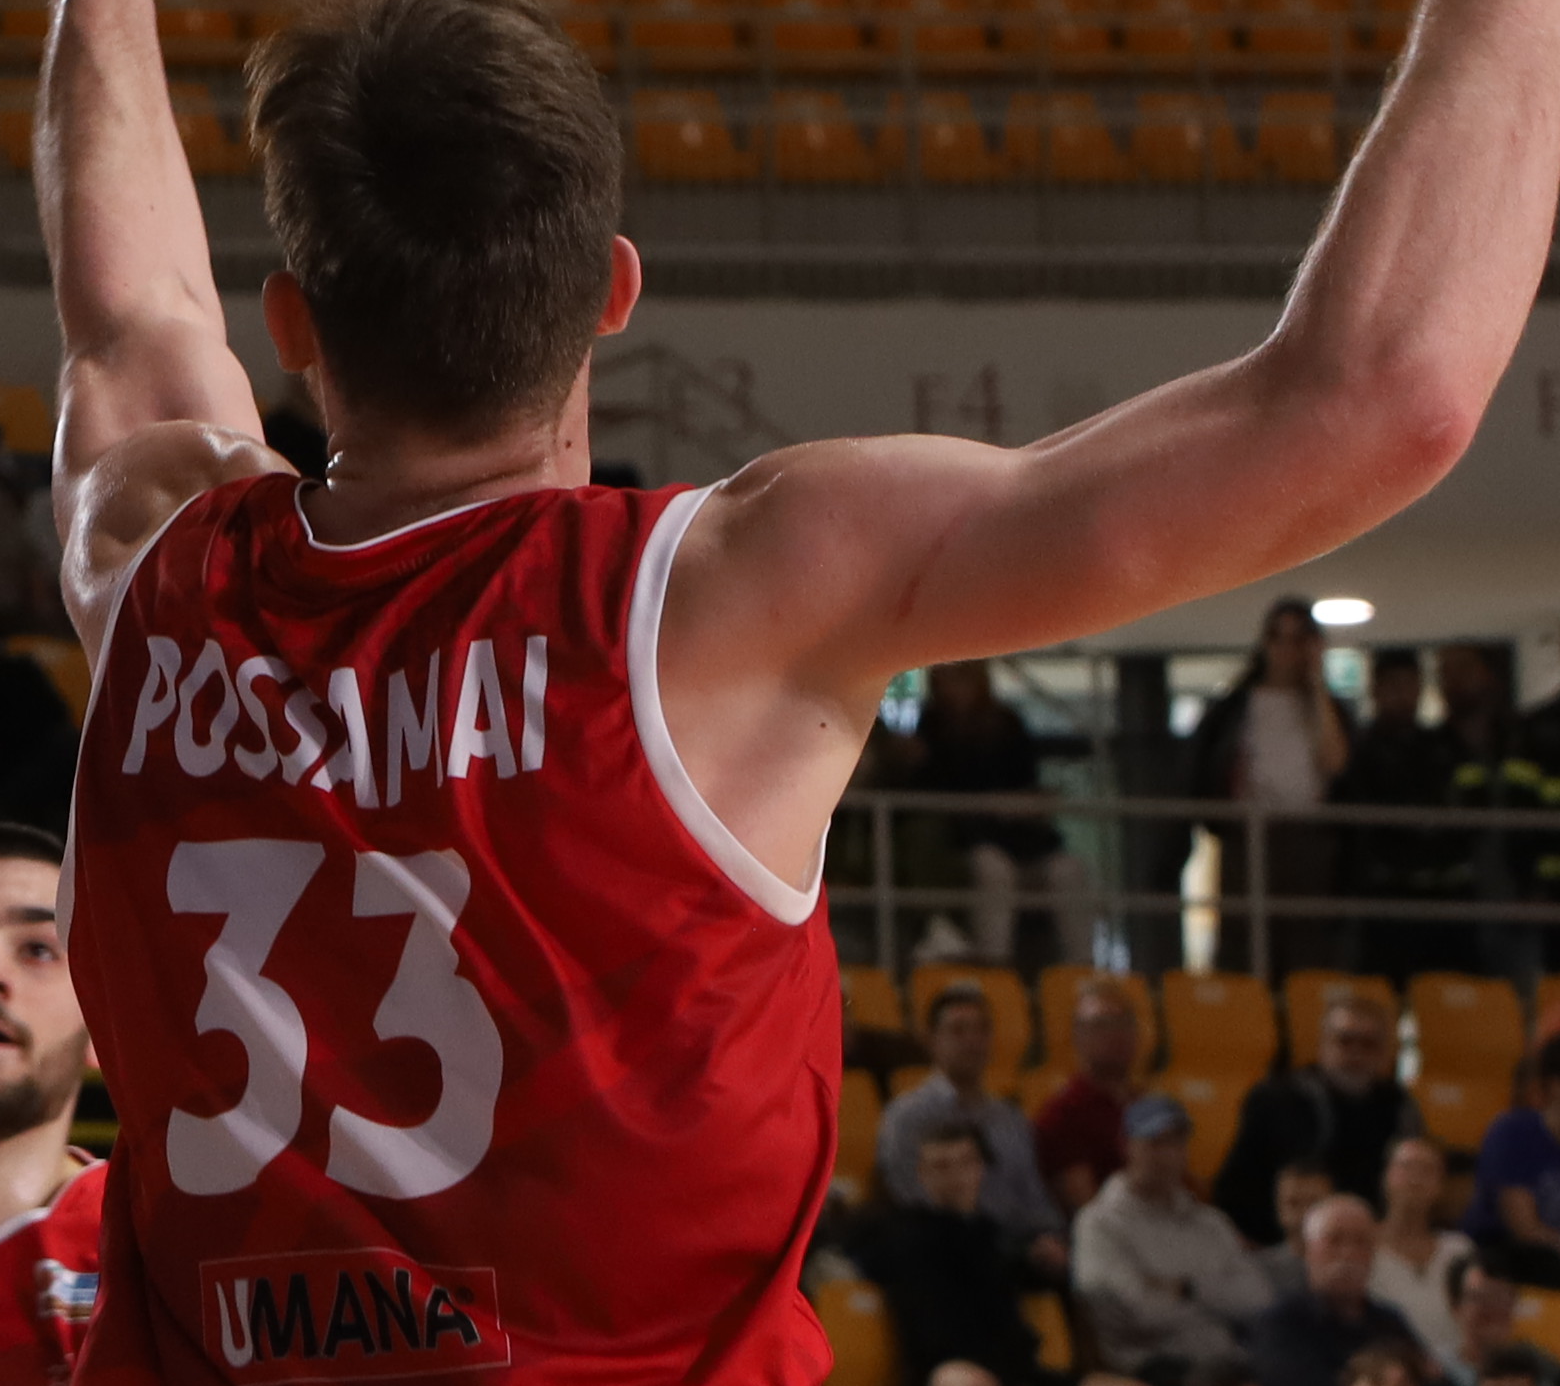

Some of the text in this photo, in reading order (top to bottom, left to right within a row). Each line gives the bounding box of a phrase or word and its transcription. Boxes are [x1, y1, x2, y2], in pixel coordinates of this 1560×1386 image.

[121, 634, 548, 809] POSSAMAI
[166, 838, 505, 1201] 33
[215, 1267, 482, 1370] UMANA
